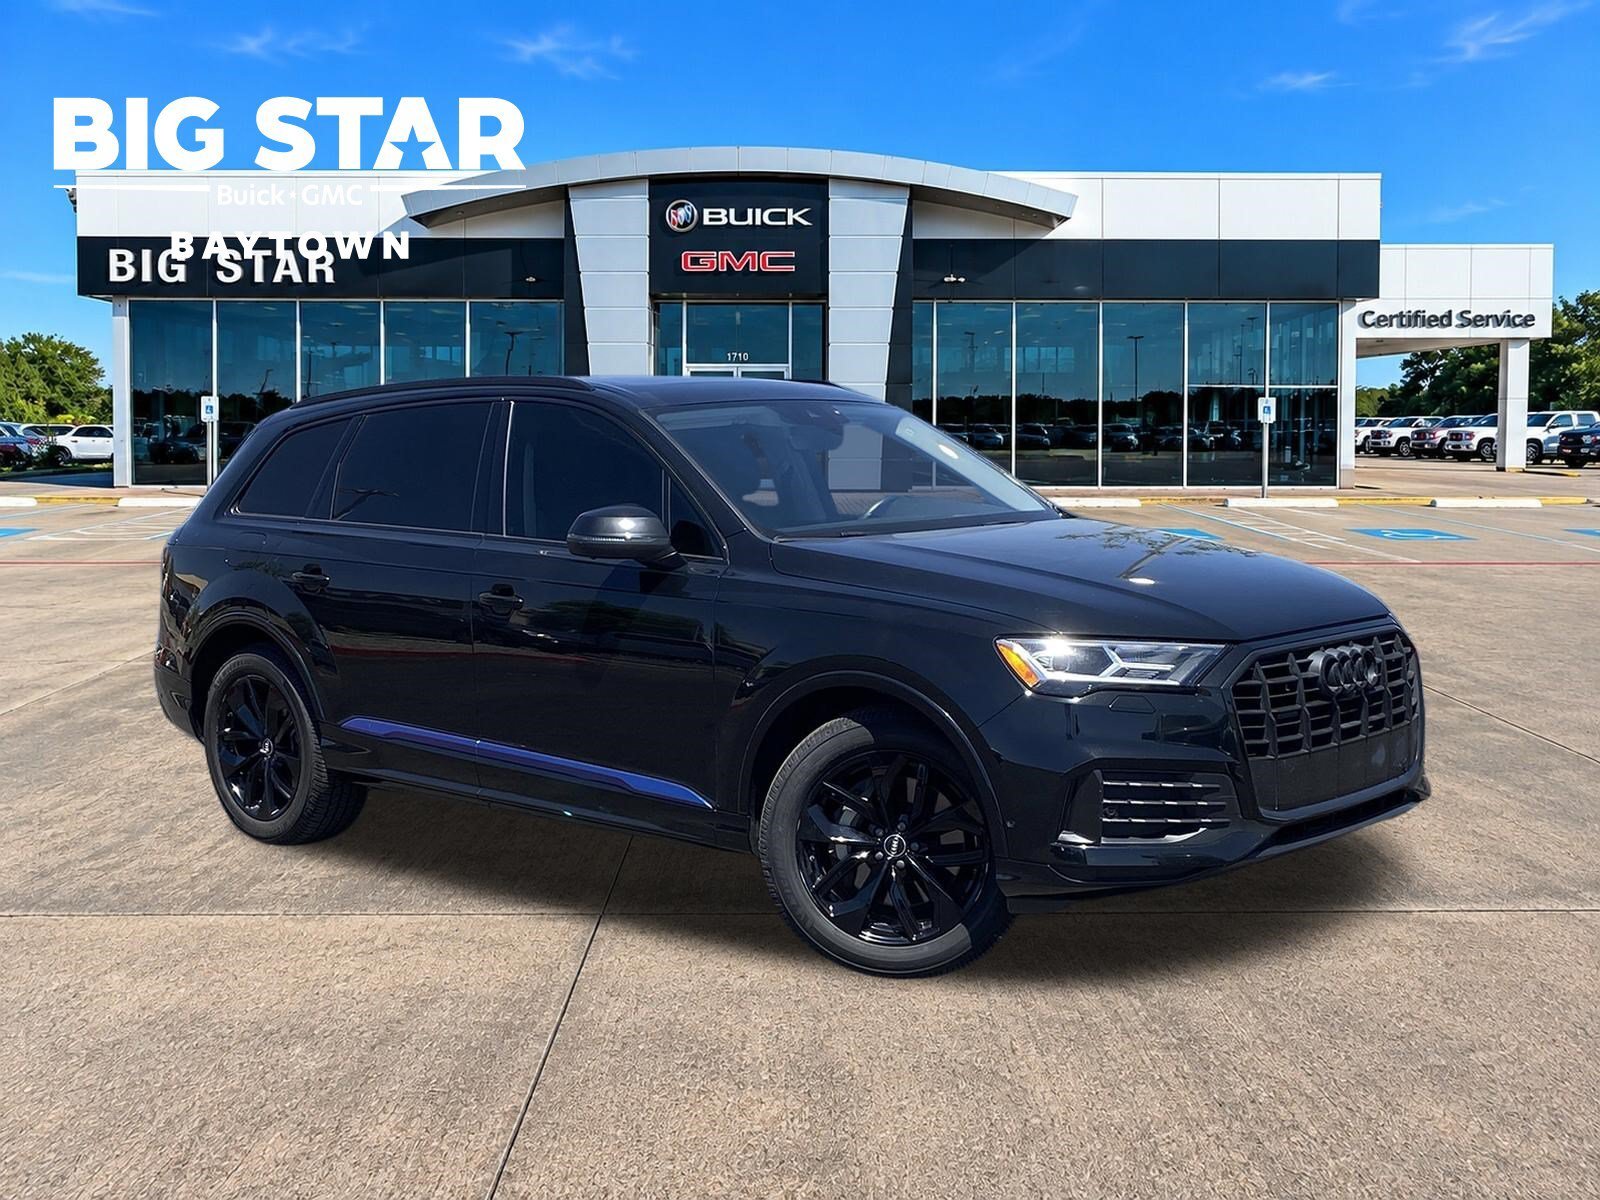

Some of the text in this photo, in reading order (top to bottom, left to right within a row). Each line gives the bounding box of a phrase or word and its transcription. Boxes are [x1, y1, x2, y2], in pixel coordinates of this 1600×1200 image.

[702, 207, 813, 226] BUICK
[108, 248, 336, 283] BIG STAR
[681, 250, 796, 272] GMC
[1360, 309, 1536, 328] Certified Service
[726, 352, 749, 362] 1710
